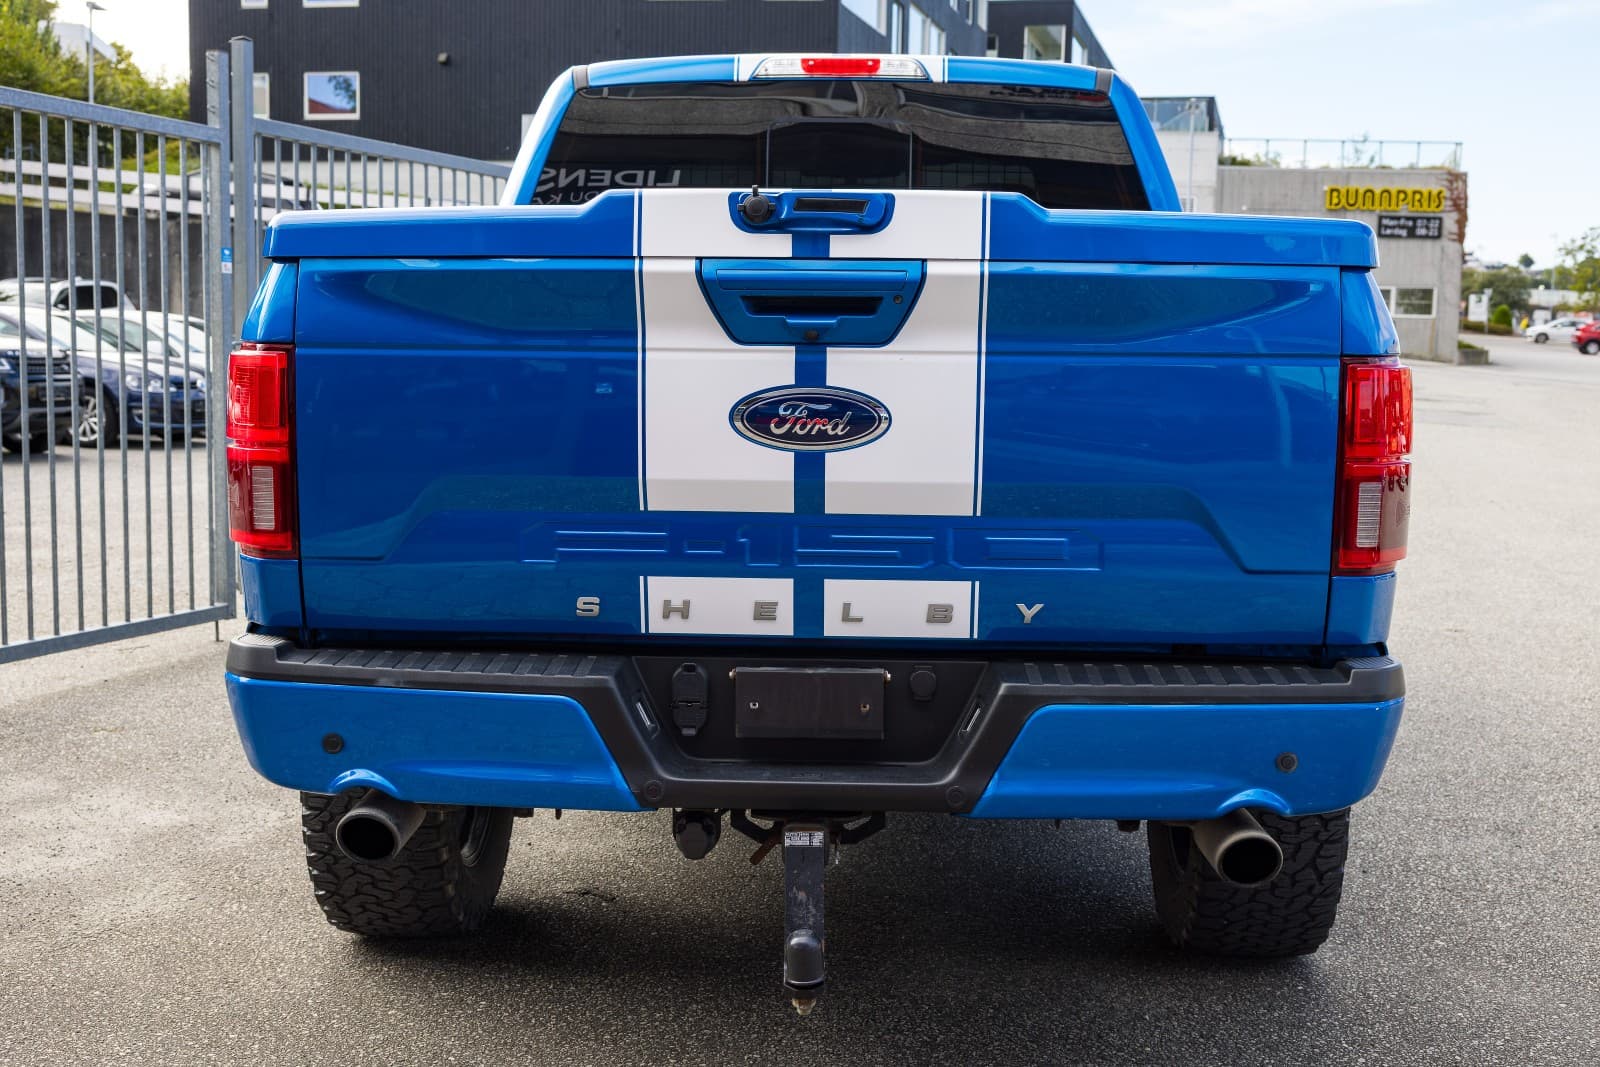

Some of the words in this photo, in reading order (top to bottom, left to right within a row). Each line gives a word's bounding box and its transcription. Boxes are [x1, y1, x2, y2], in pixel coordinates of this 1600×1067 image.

[1326, 186, 1446, 211] BUNNPRIS
[769, 401, 851, 436] Ford
[521, 521, 1103, 571] F-150
[576, 596, 1045, 624] SHELBY
